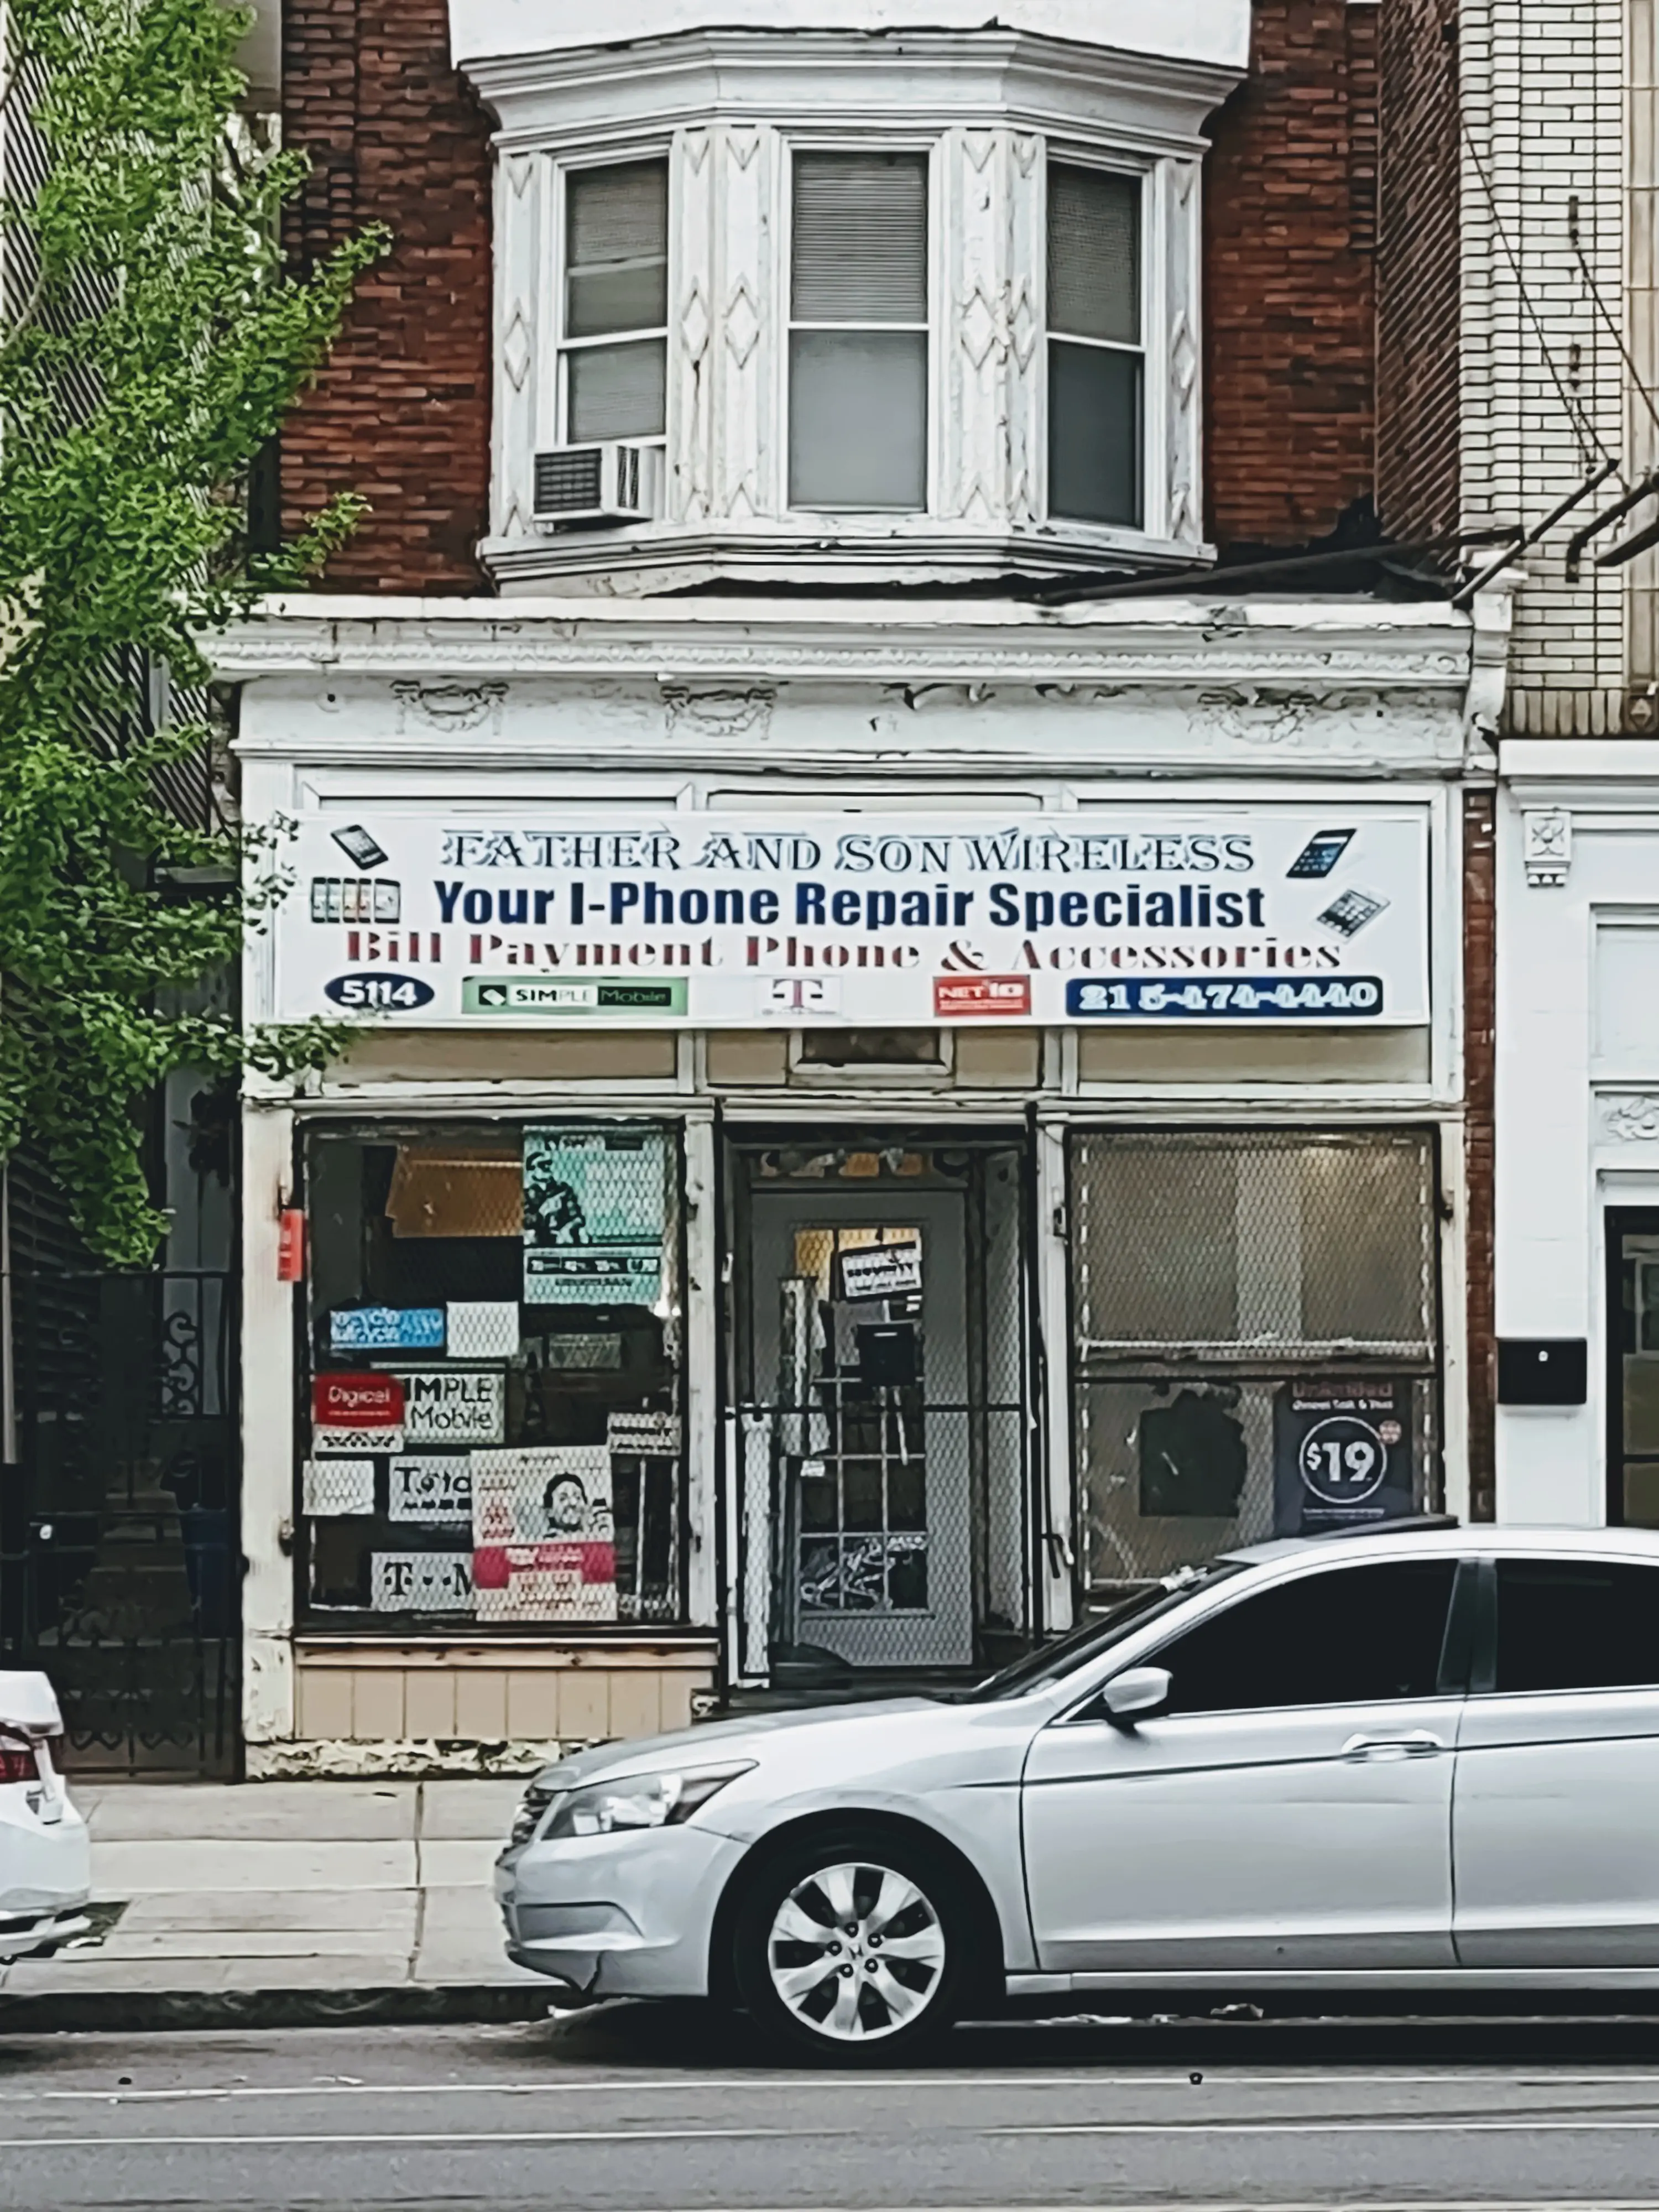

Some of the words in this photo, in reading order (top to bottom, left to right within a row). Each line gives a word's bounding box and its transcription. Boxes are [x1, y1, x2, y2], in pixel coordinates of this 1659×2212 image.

[442, 830, 681, 870] FATHER
[696, 832, 821, 871] AND
[836, 834, 950, 873] SON
[965, 830, 1255, 873] WIRELESS
[434, 880, 555, 925] Your
[571, 881, 779, 926] I-Phone
[796, 883, 974, 931] Repair
[989, 883, 1265, 932] Specialist
[347, 931, 441, 963] Bill
[470, 933, 723, 972] Payment
[745, 936, 920, 968] Phone
[941, 939, 989, 971] &
[1013, 937, 1341, 971] Accessories
[341, 981, 417, 1007] 5114
[516, 989, 589, 1002] SIMPLE
[1079, 983, 1379, 1010] 215-474-4440
[328, 1386, 390, 1407] Digicel
[404, 1377, 492, 1402] IMPLE
[1306, 1441, 1375, 1482] $19
